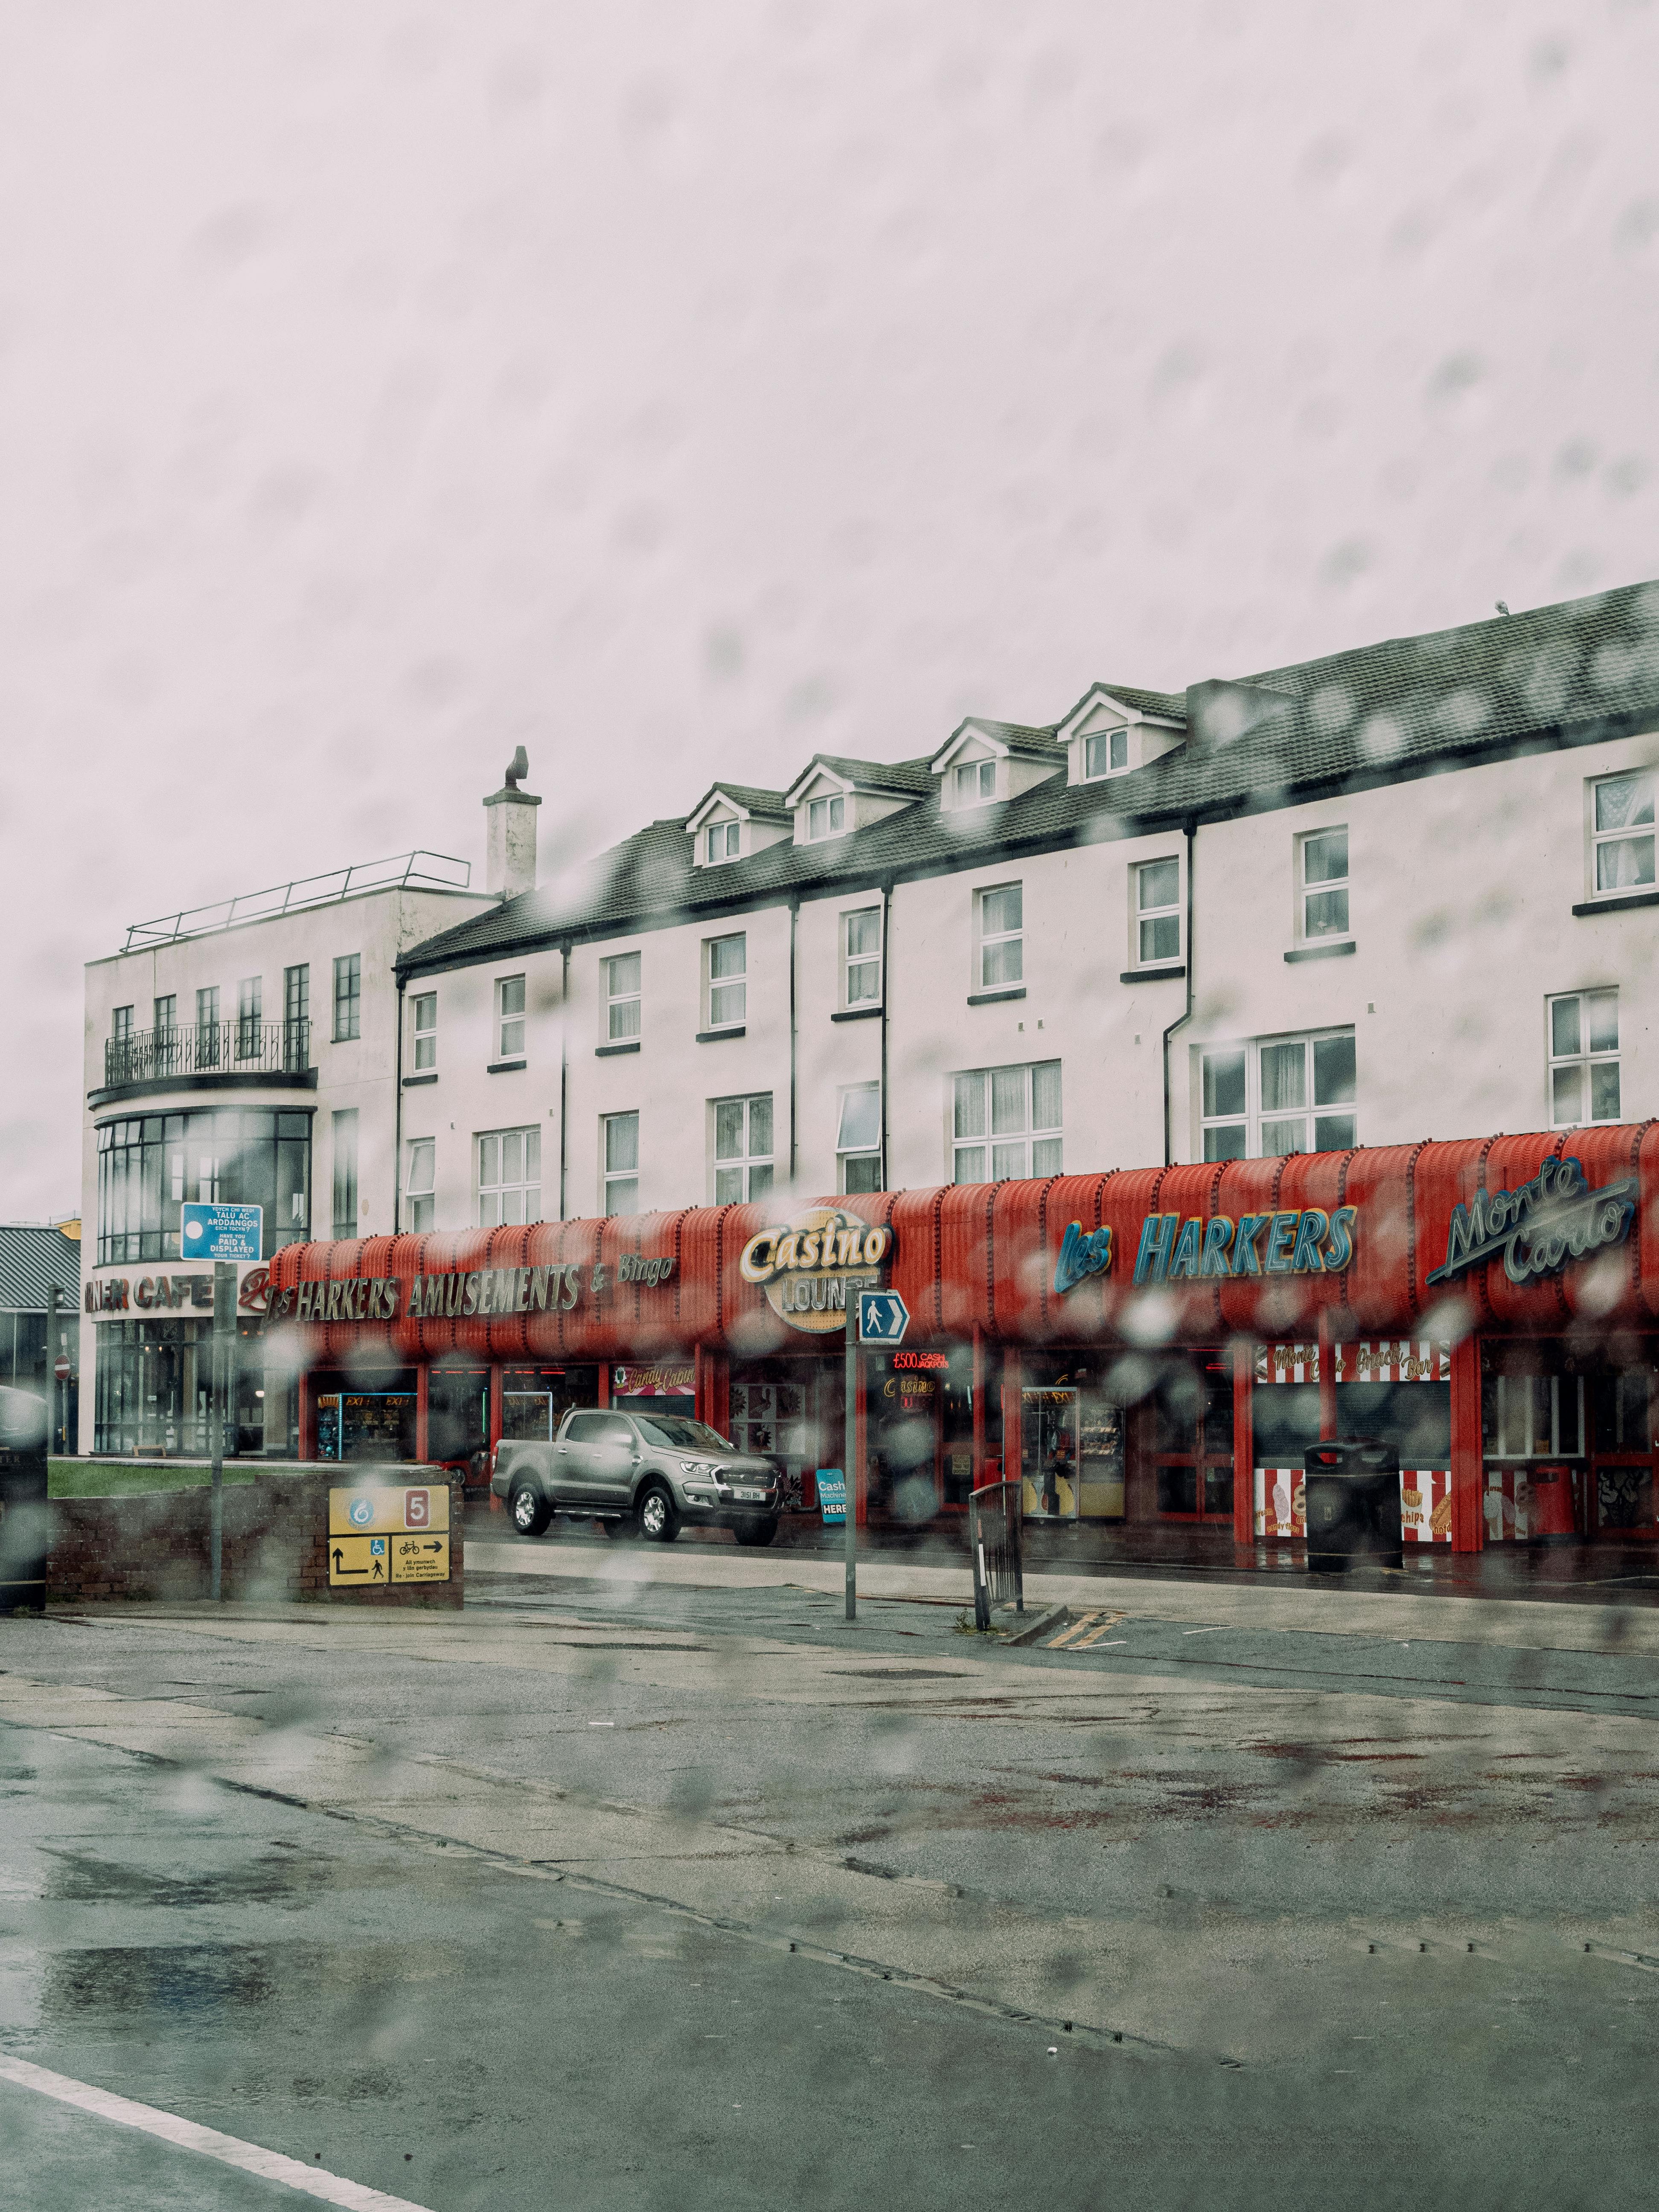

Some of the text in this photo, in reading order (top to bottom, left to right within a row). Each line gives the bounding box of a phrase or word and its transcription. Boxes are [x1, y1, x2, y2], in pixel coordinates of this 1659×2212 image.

[207, 1218, 258, 1227] ARDDANGOS
[1446, 1156, 1585, 1277] Monte
[210, 1245, 254, 1253] DISPLAYED
[739, 1216, 886, 1283] Casino
[1054, 1206, 1356, 1293] Les HARKERS
[1504, 1201, 1631, 1284] Carlo
[134, 1275, 213, 1309] CAFE
[296, 1277, 399, 1321] HARKERS
[406, 1264, 579, 1317] AMUSEMENTS
[590, 1263, 604, 1292] &
[618, 1254, 676, 1287] Bingo
[782, 1274, 877, 1311] LOUN
[894, 1353, 917, 1368] £500
[917, 1360, 949, 1368] JACKPOTS
[1274, 1345, 1316, 1371] Monte
[1356, 1343, 1403, 1374] Snack
[1401, 1356, 1433, 1380] Bar
[884, 1377, 935, 1397] Casino
[818, 1481, 845, 1491] Cash
[410, 1497, 424, 1519] 5
[823, 1505, 846, 1514] HERE
[1401, 1511, 1423, 1525] chips
